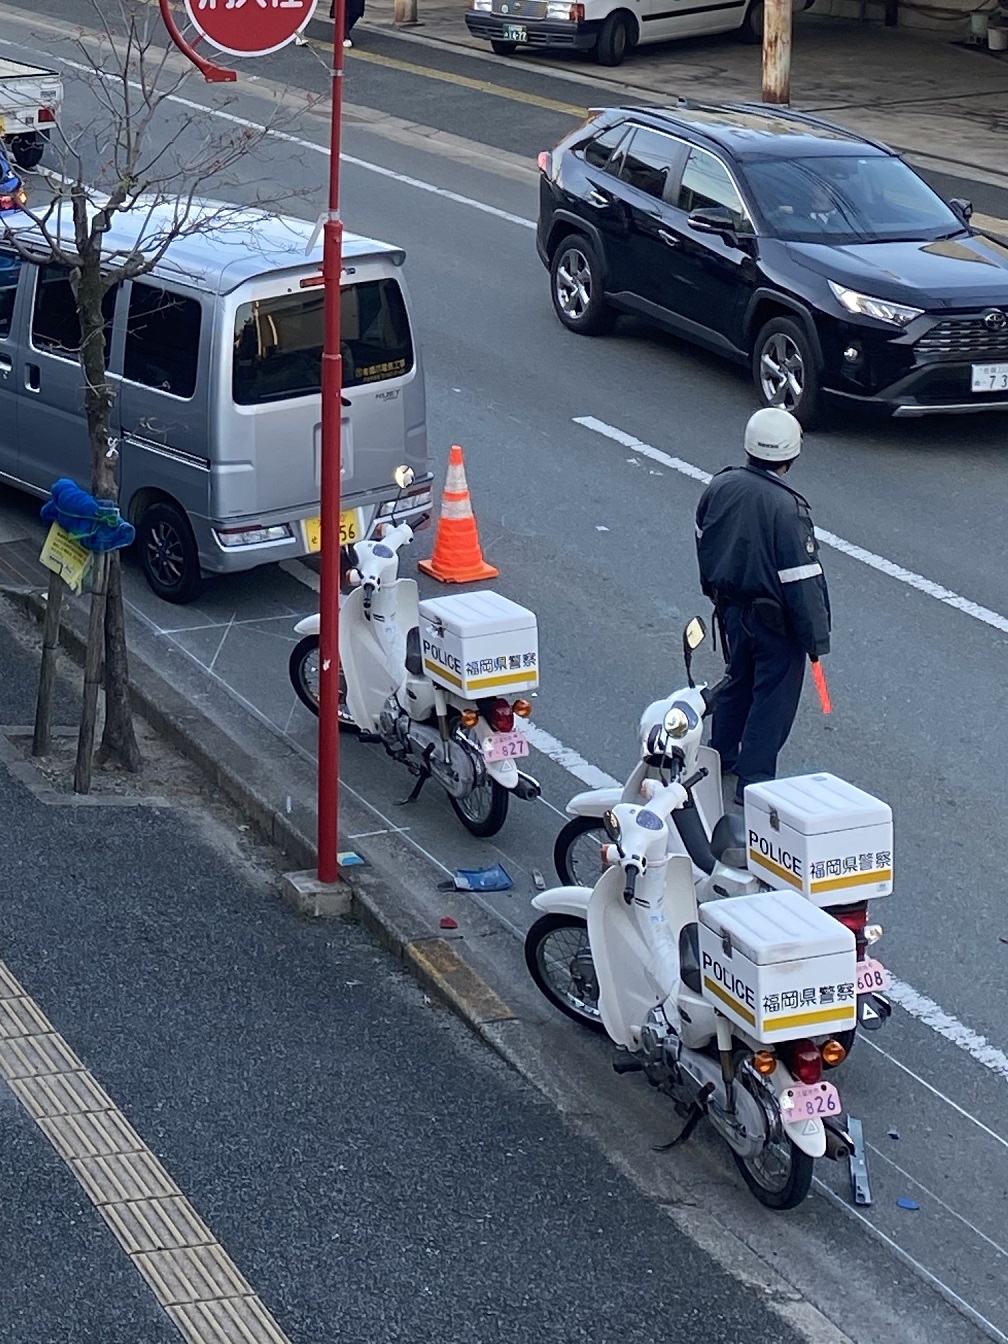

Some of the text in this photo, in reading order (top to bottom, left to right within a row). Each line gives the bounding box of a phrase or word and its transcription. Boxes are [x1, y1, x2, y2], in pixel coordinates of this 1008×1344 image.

[422, 639, 463, 675] POLICE
[466, 652, 537, 676] 福岡県警察
[502, 740, 524, 757] 827
[748, 829, 803, 878] POLICE
[810, 850, 892, 879] 福岡県警察
[702, 951, 756, 1010] POLICE
[857, 970, 884, 990] 608
[763, 982, 855, 1014] 福岡県警察
[805, 1094, 836, 1115] 826
